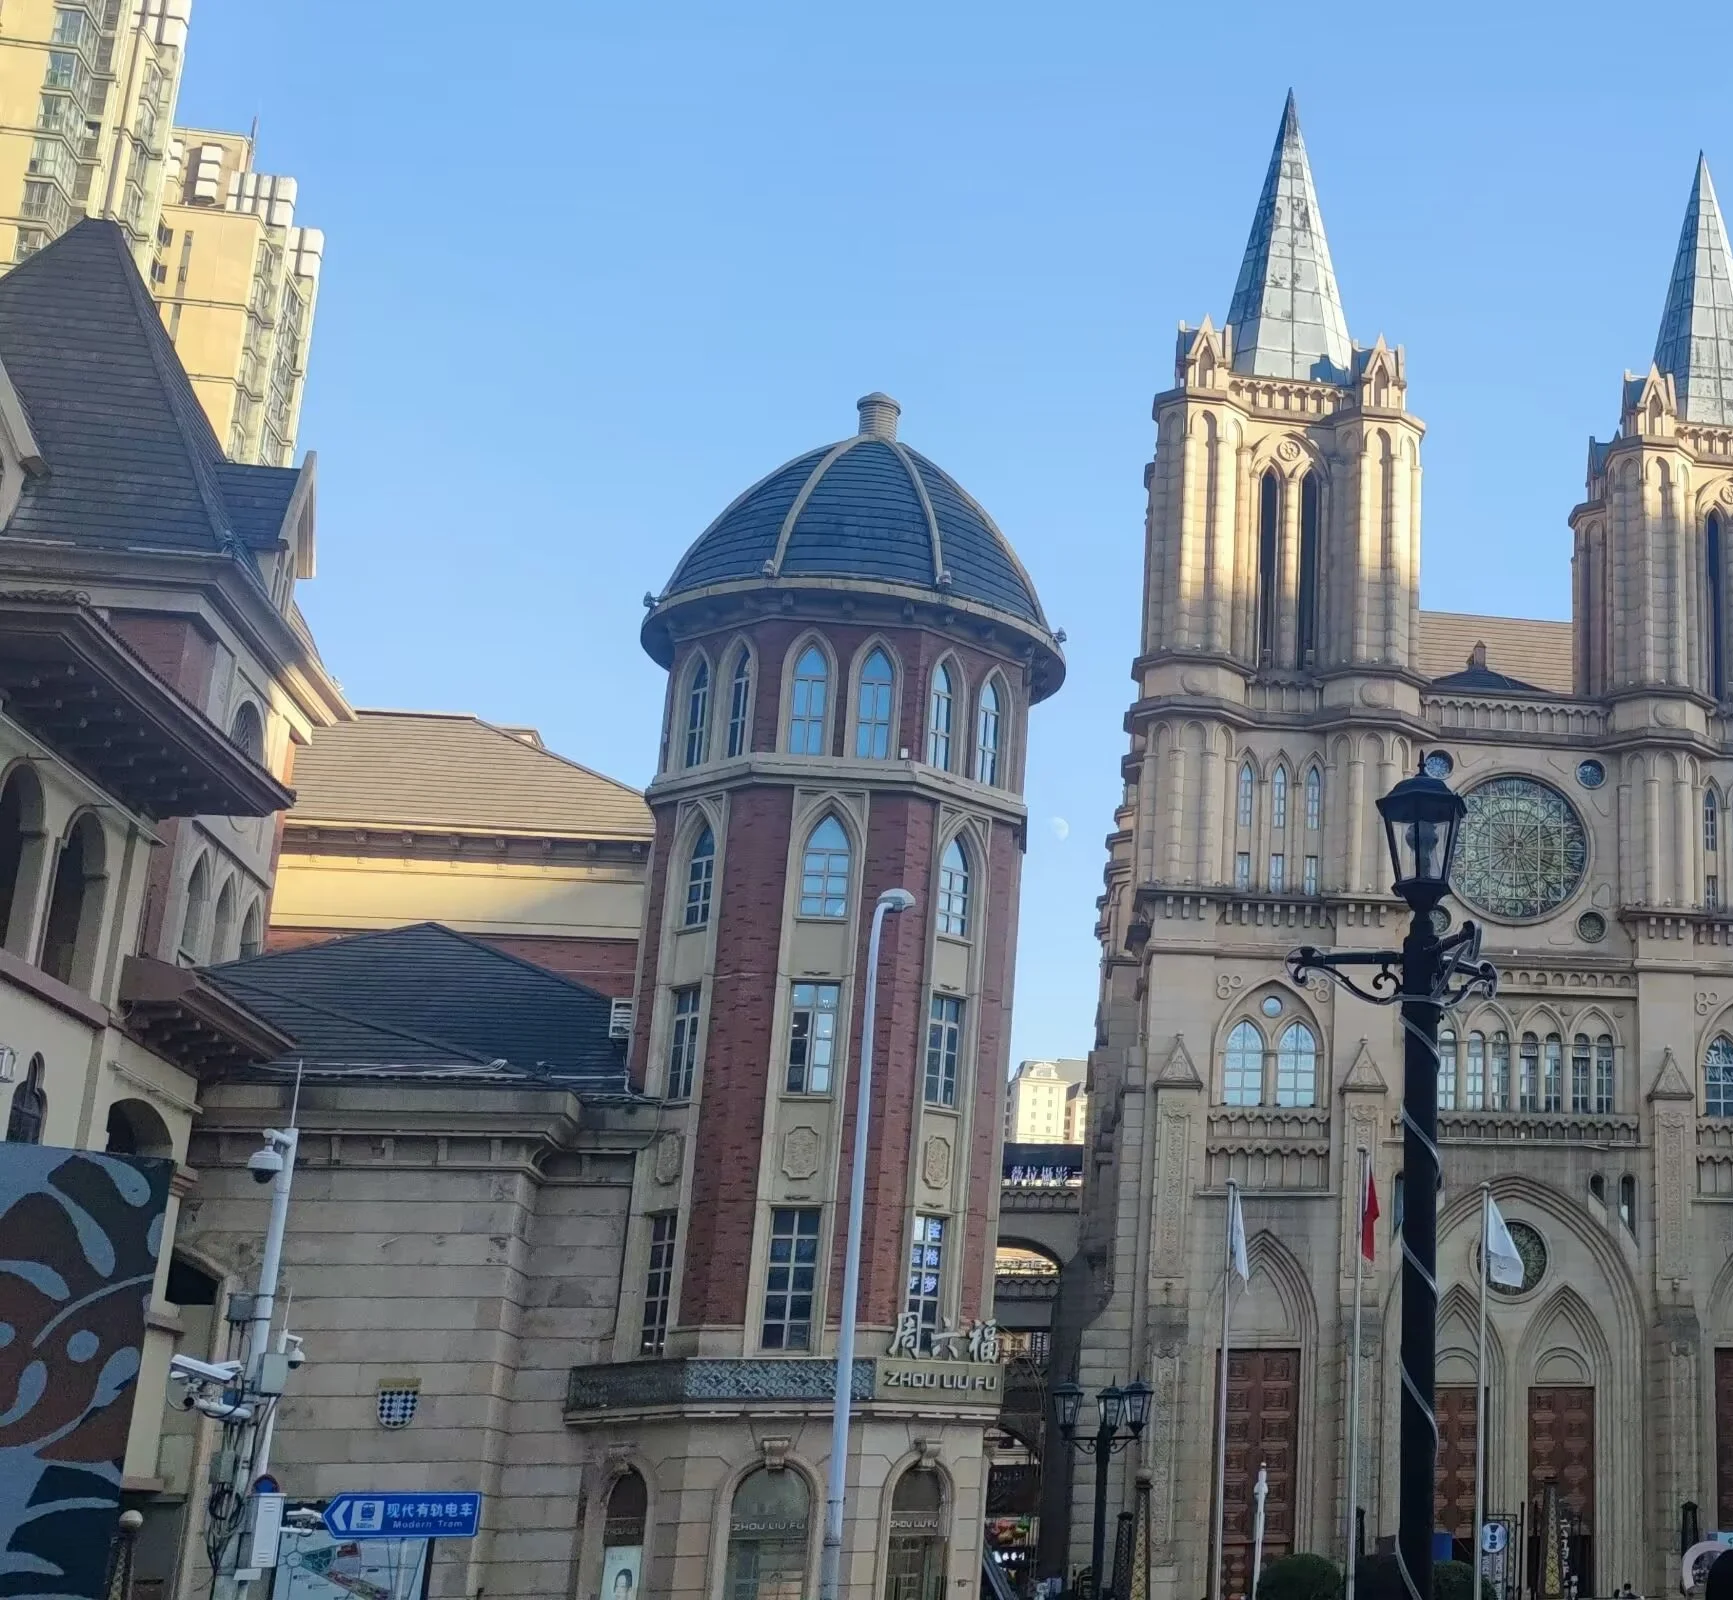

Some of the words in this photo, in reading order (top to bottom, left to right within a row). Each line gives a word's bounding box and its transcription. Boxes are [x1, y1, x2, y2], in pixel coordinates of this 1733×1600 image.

[888, 1312, 999, 1363] 周六福
[886, 1371, 937, 1388] ZHOU
[943, 1373, 968, 1389] LIU
[975, 1376, 997, 1390] FU
[386, 1502, 473, 1518] 现代有轨电车
[393, 1520, 432, 1529] Modern
[438, 1519, 463, 1528] Tram
[732, 1523, 765, 1532] ZHOU
[768, 1522, 786, 1530] LIU
[789, 1521, 805, 1530] FU
[890, 1520, 912, 1529] ZHOU
